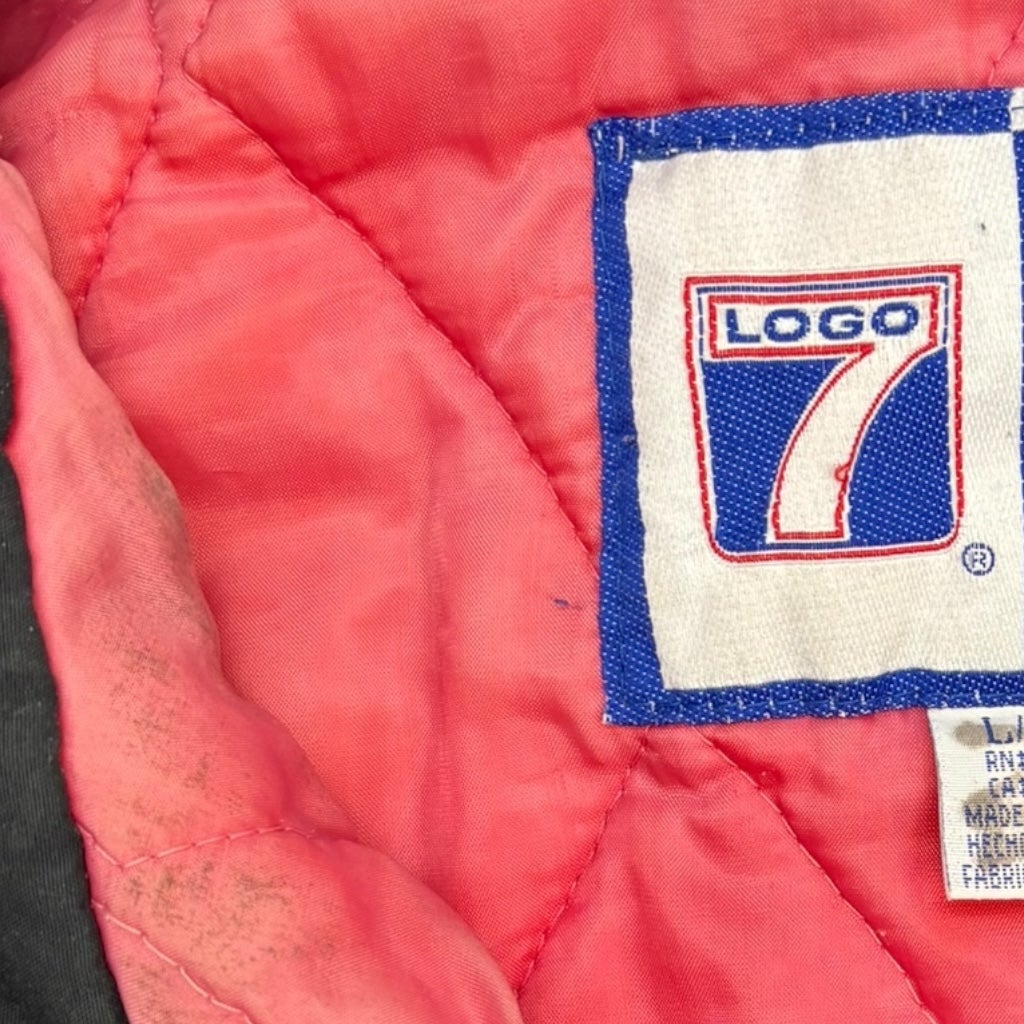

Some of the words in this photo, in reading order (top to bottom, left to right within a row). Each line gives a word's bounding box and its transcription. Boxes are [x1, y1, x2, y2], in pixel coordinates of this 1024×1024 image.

[725, 301, 920, 343] LOGO
[708, 284, 942, 541] 7
[964, 804, 1023, 828] MADE
